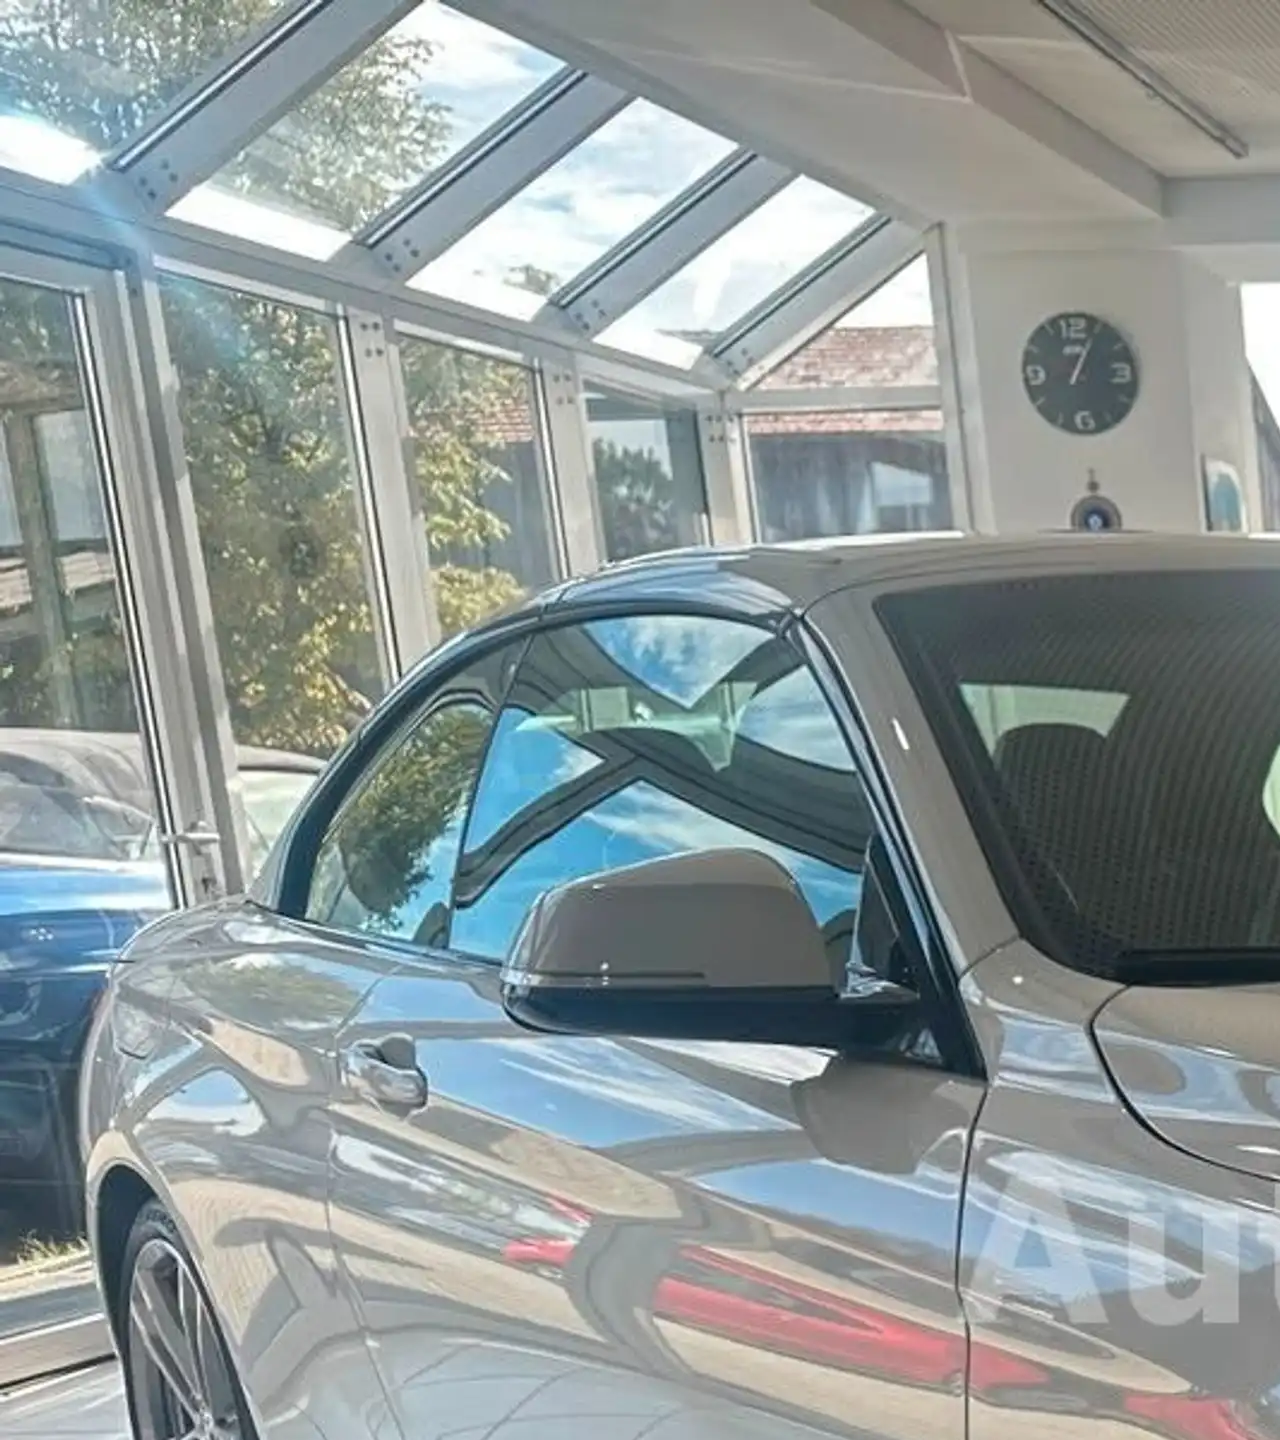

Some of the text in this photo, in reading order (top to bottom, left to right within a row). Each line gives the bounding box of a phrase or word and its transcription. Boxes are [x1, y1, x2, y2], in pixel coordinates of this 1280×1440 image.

[1059, 317, 1088, 340] 12
[1025, 365, 1046, 386] 9
[1110, 362, 1132, 384] 3
